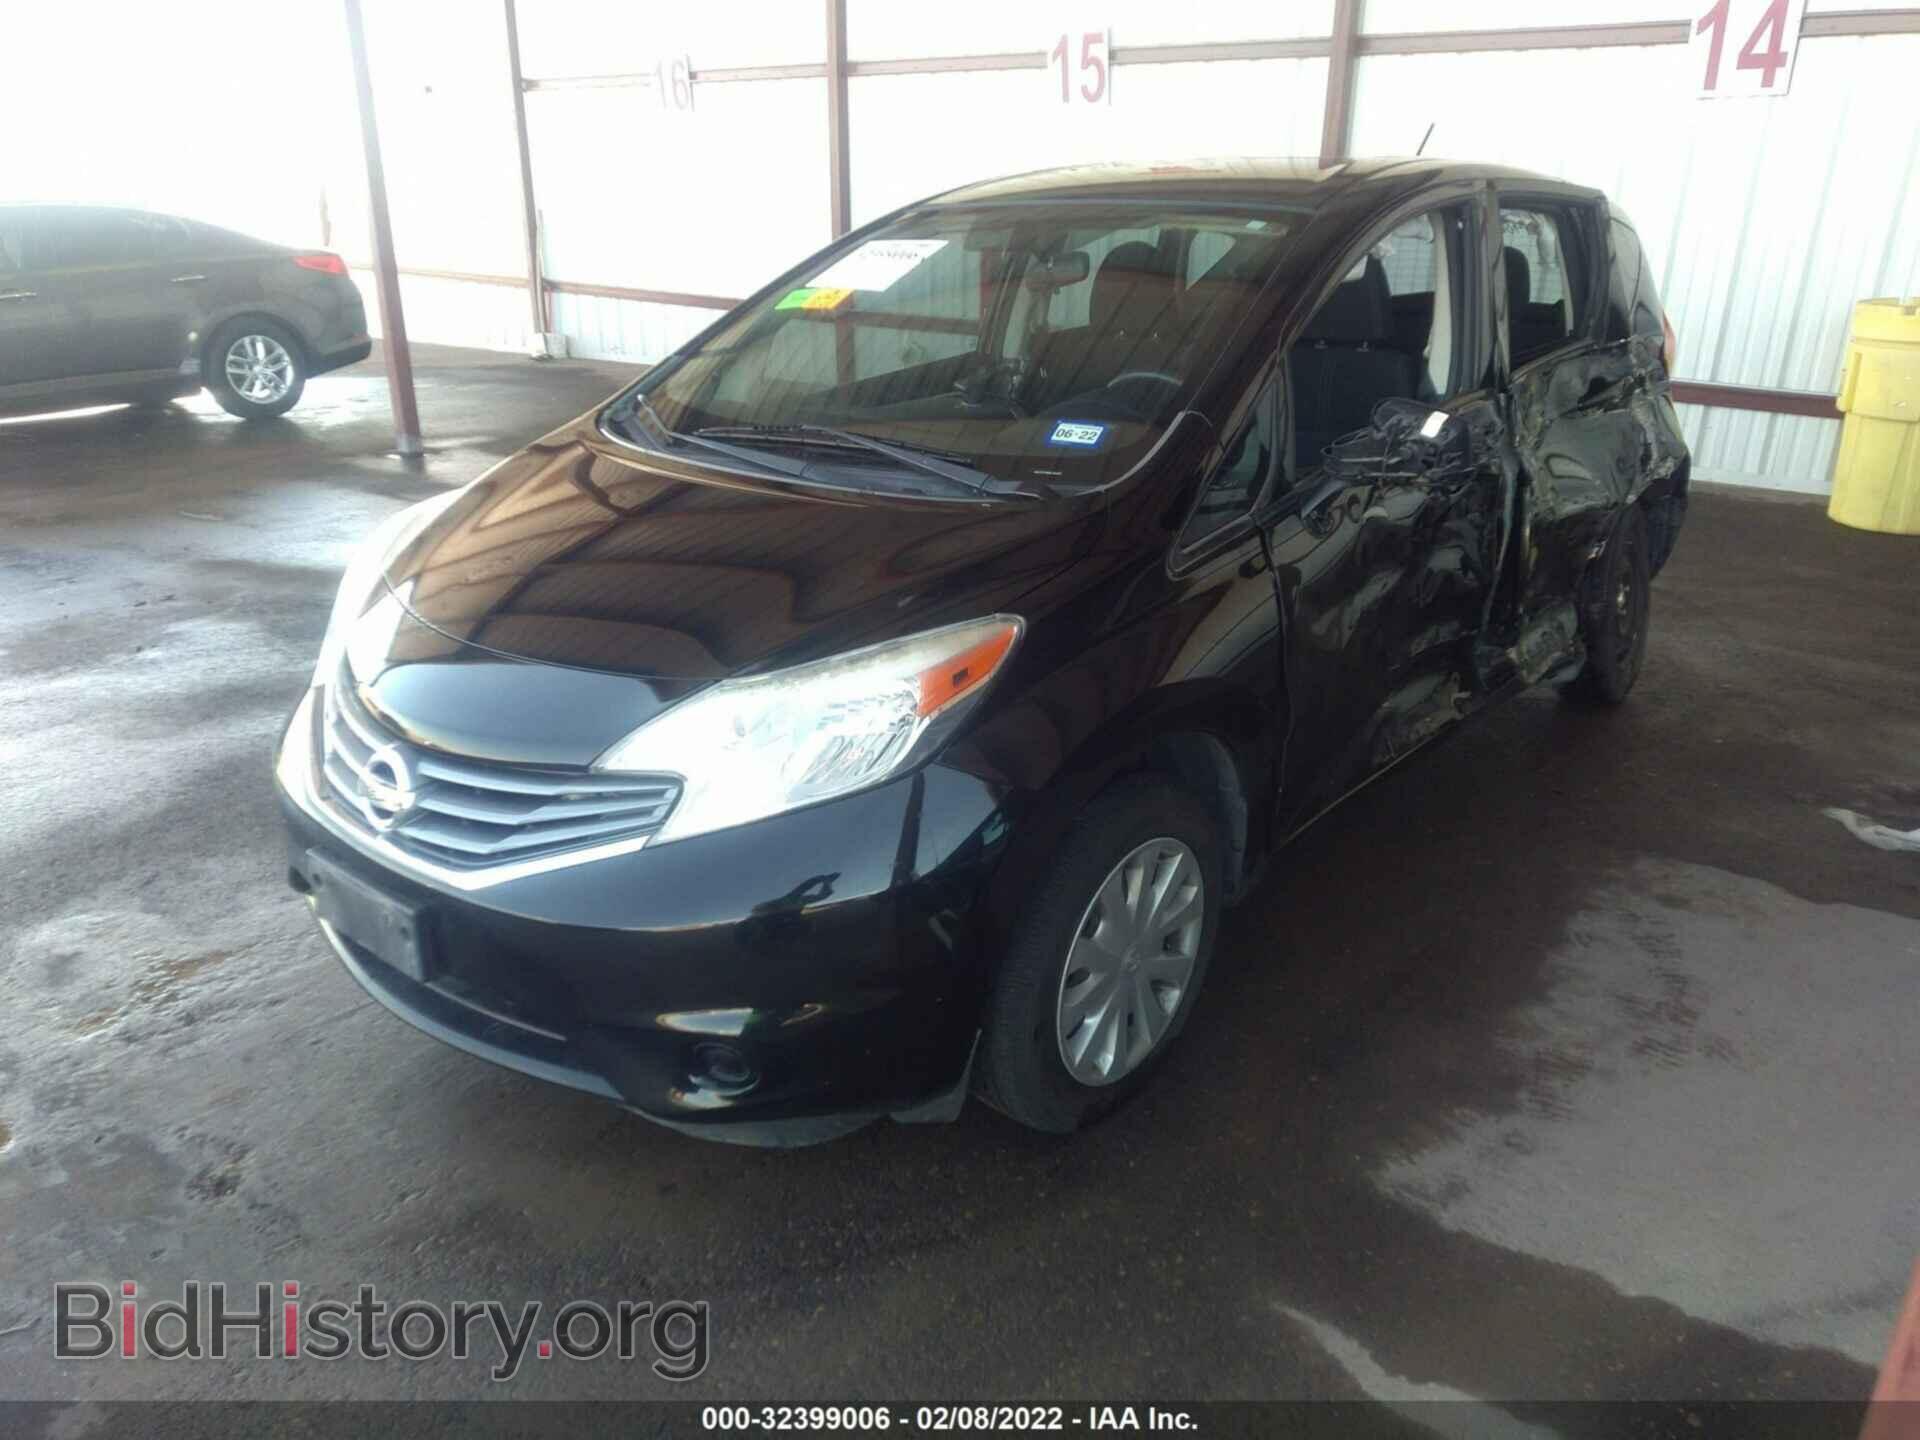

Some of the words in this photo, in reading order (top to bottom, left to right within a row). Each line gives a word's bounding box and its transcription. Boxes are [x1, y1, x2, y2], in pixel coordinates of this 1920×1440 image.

[1052, 32, 1105, 103] 15
[1696, 0, 1789, 90] 14
[655, 58, 689, 110] 16
